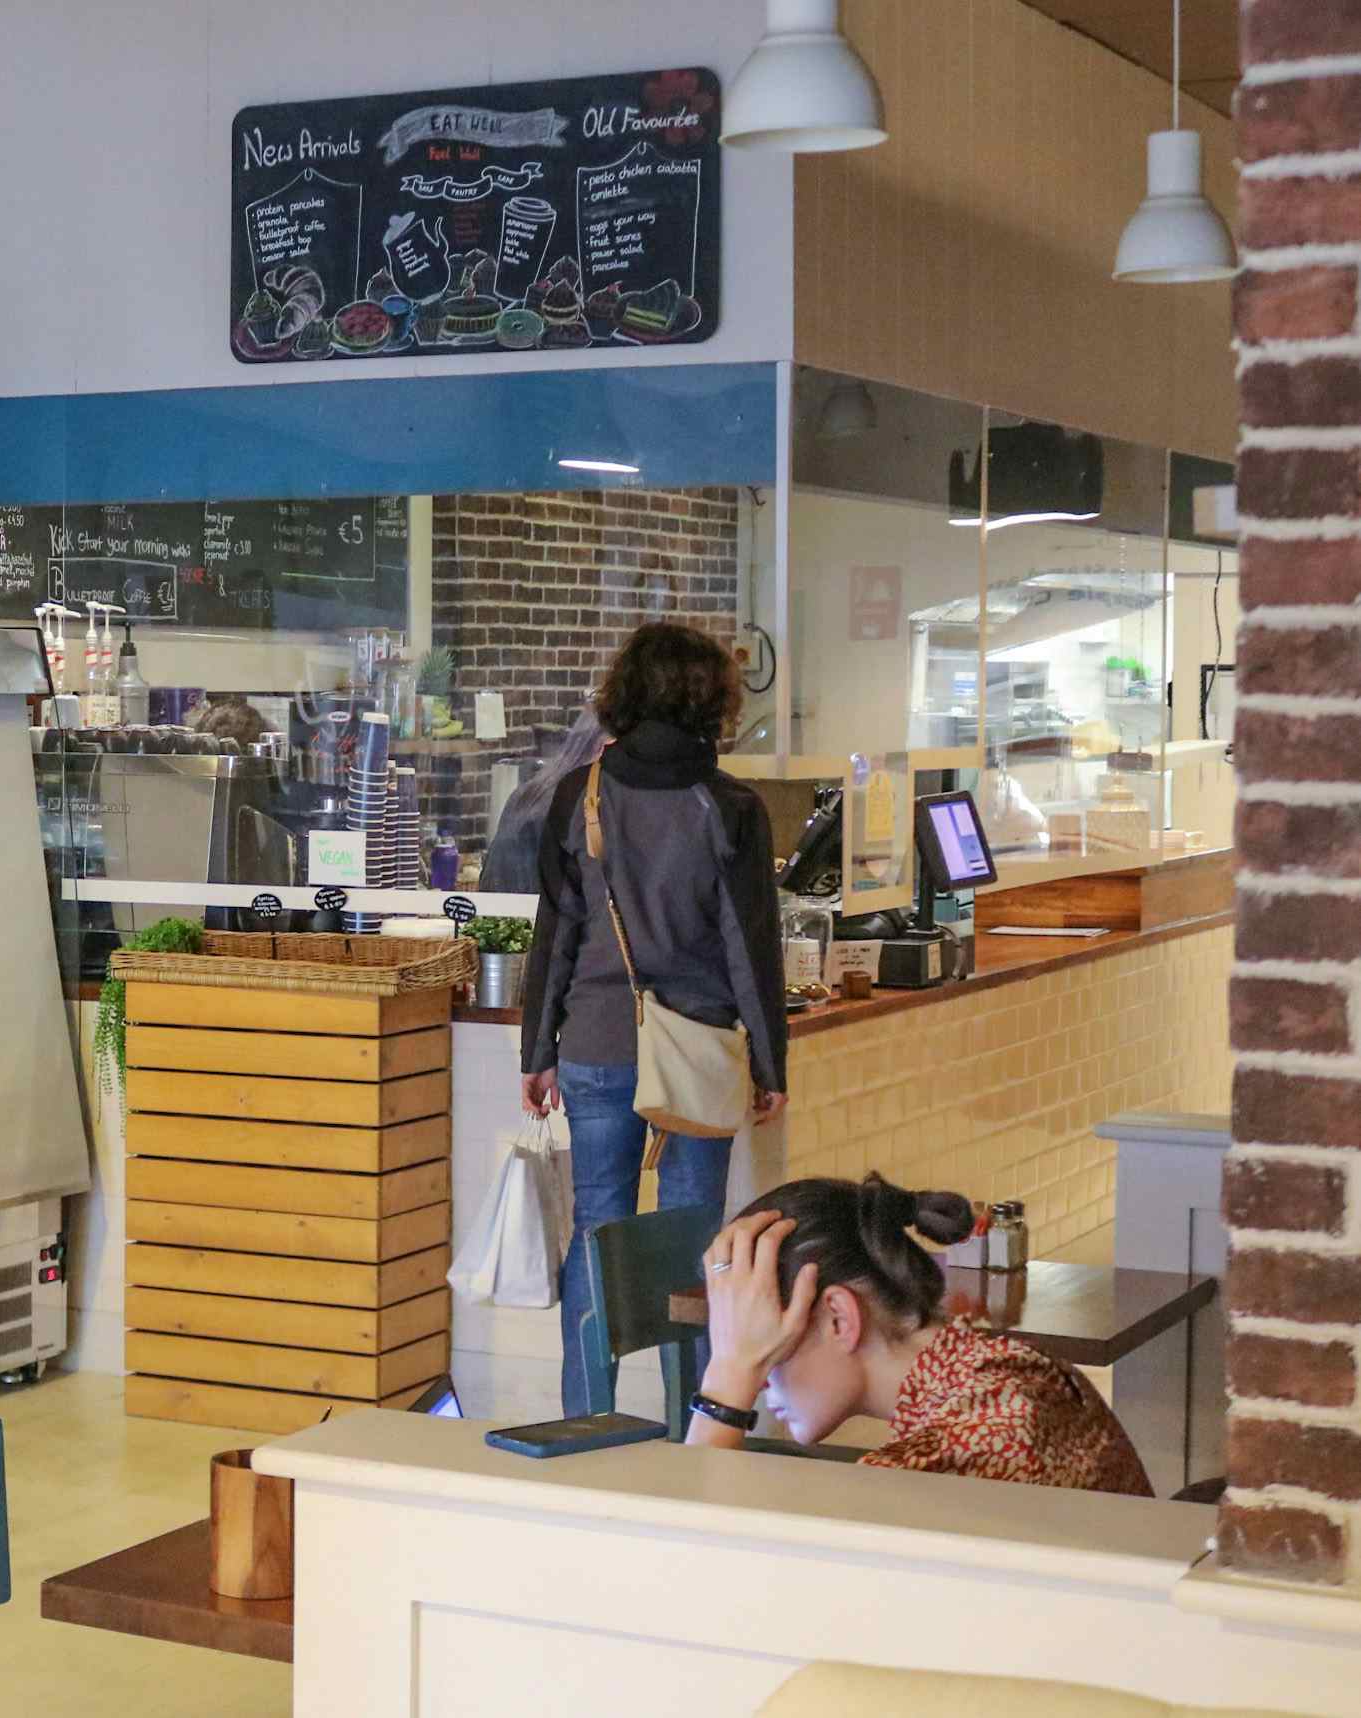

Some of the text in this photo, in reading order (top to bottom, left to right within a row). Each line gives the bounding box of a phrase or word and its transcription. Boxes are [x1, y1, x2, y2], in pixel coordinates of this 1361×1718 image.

[430, 113, 463, 131] EAT
[583, 106, 700, 138] Old Favourites
[243, 127, 361, 170] New Arrivals
[338, 515, 364, 544] €5
